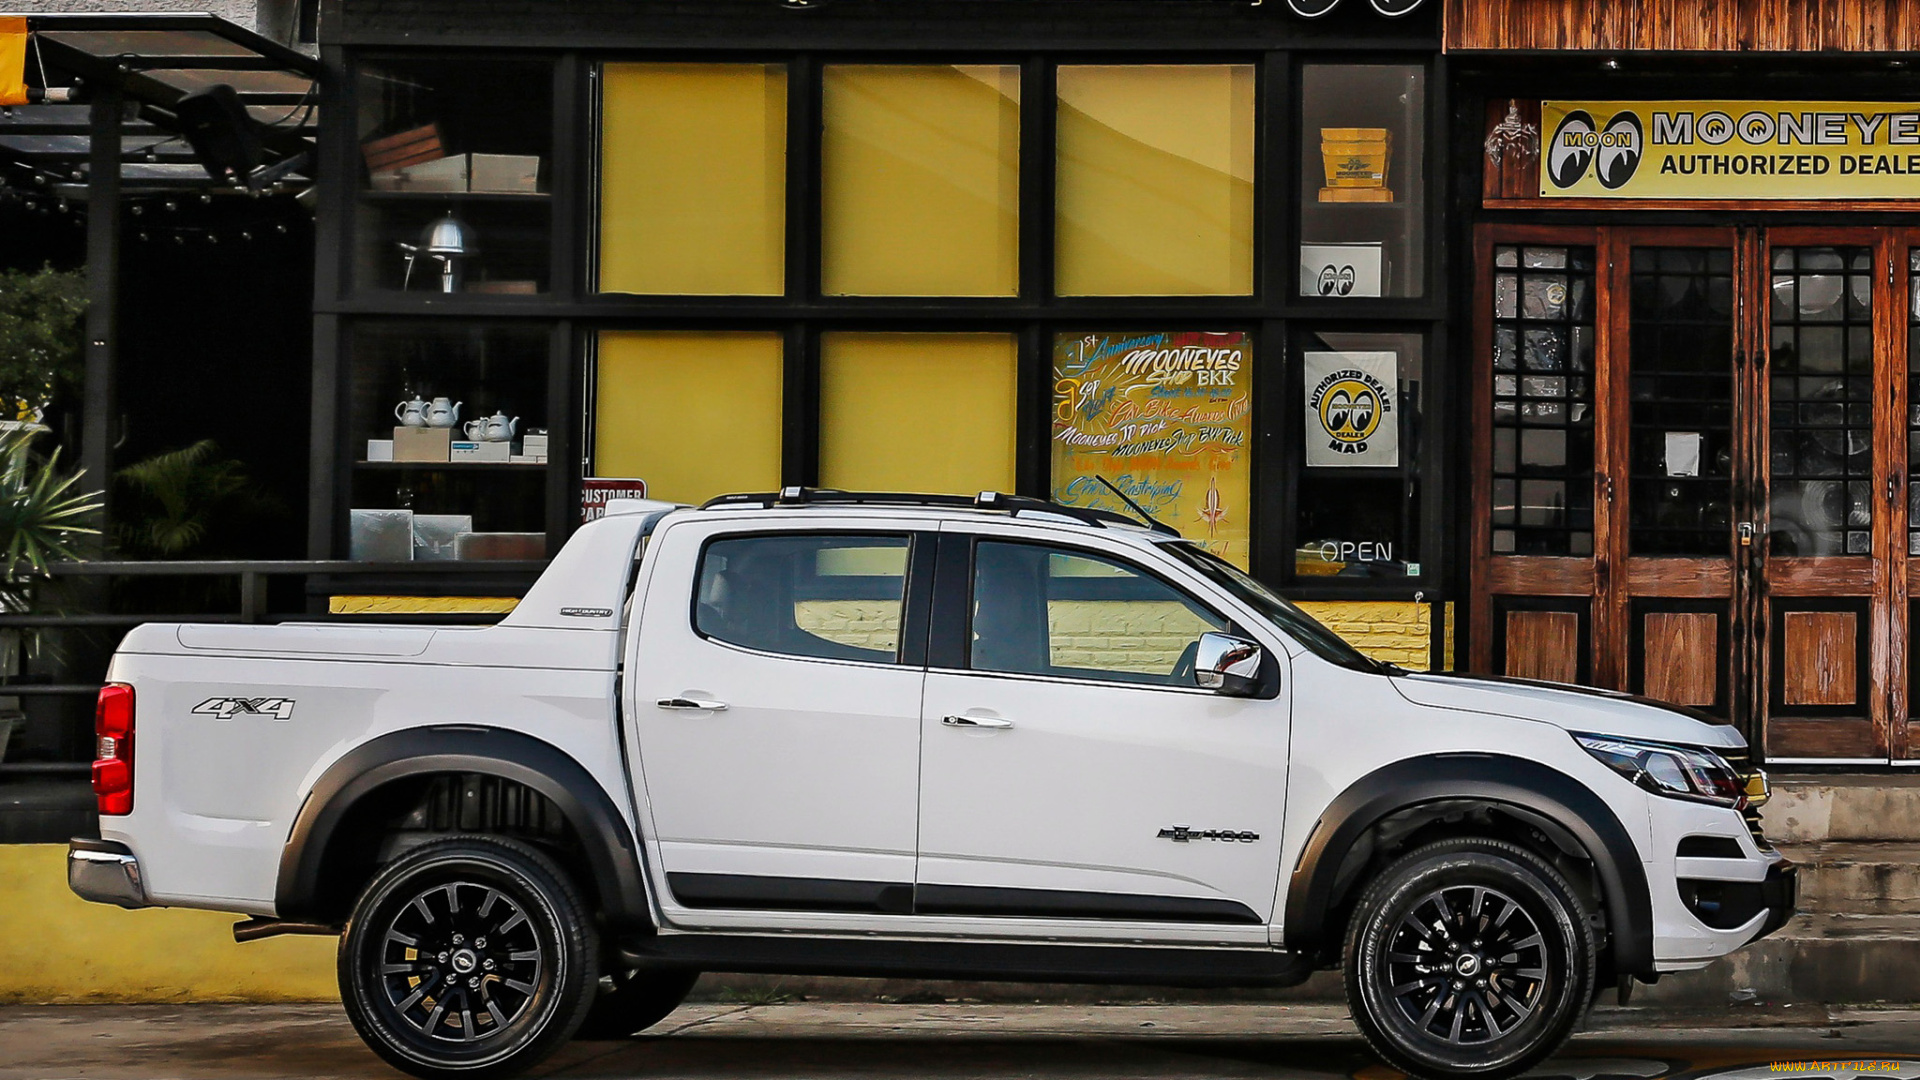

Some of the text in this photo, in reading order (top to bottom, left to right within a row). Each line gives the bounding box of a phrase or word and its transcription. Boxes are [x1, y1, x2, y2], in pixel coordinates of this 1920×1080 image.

[1651, 111, 1920, 146] MOONEYE
[1563, 131, 1632, 148] MOON
[1660, 154, 1920, 175] AUTHORIZED DEALE
[1120, 348, 1242, 375] MOONEYES
[1196, 369, 1237, 387] BKK
[1310, 369, 1391, 413] AUTHORIZED DEALER
[1328, 439, 1368, 454] MAD
[1320, 541, 1392, 562] OPEN
